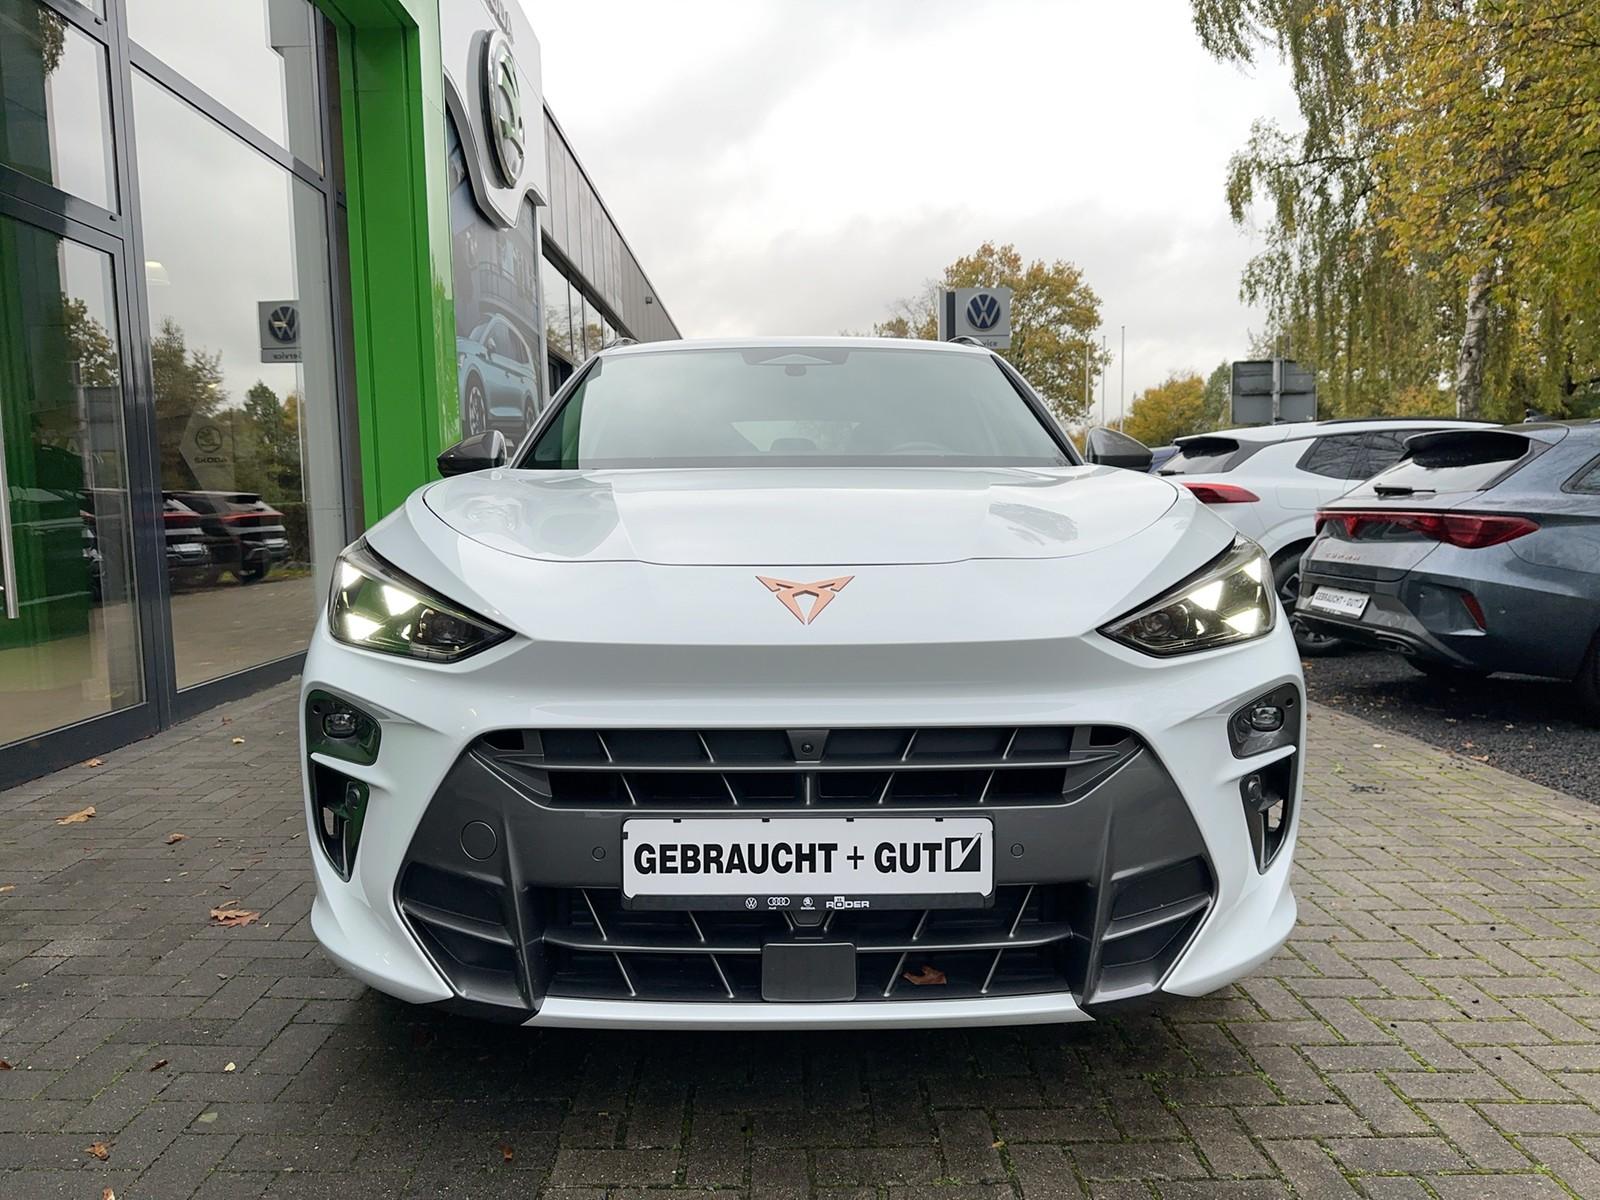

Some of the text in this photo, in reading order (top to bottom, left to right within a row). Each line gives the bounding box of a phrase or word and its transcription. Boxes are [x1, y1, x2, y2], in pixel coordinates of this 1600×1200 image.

[634, 842, 943, 875] GEBRAUCHT + GUT
